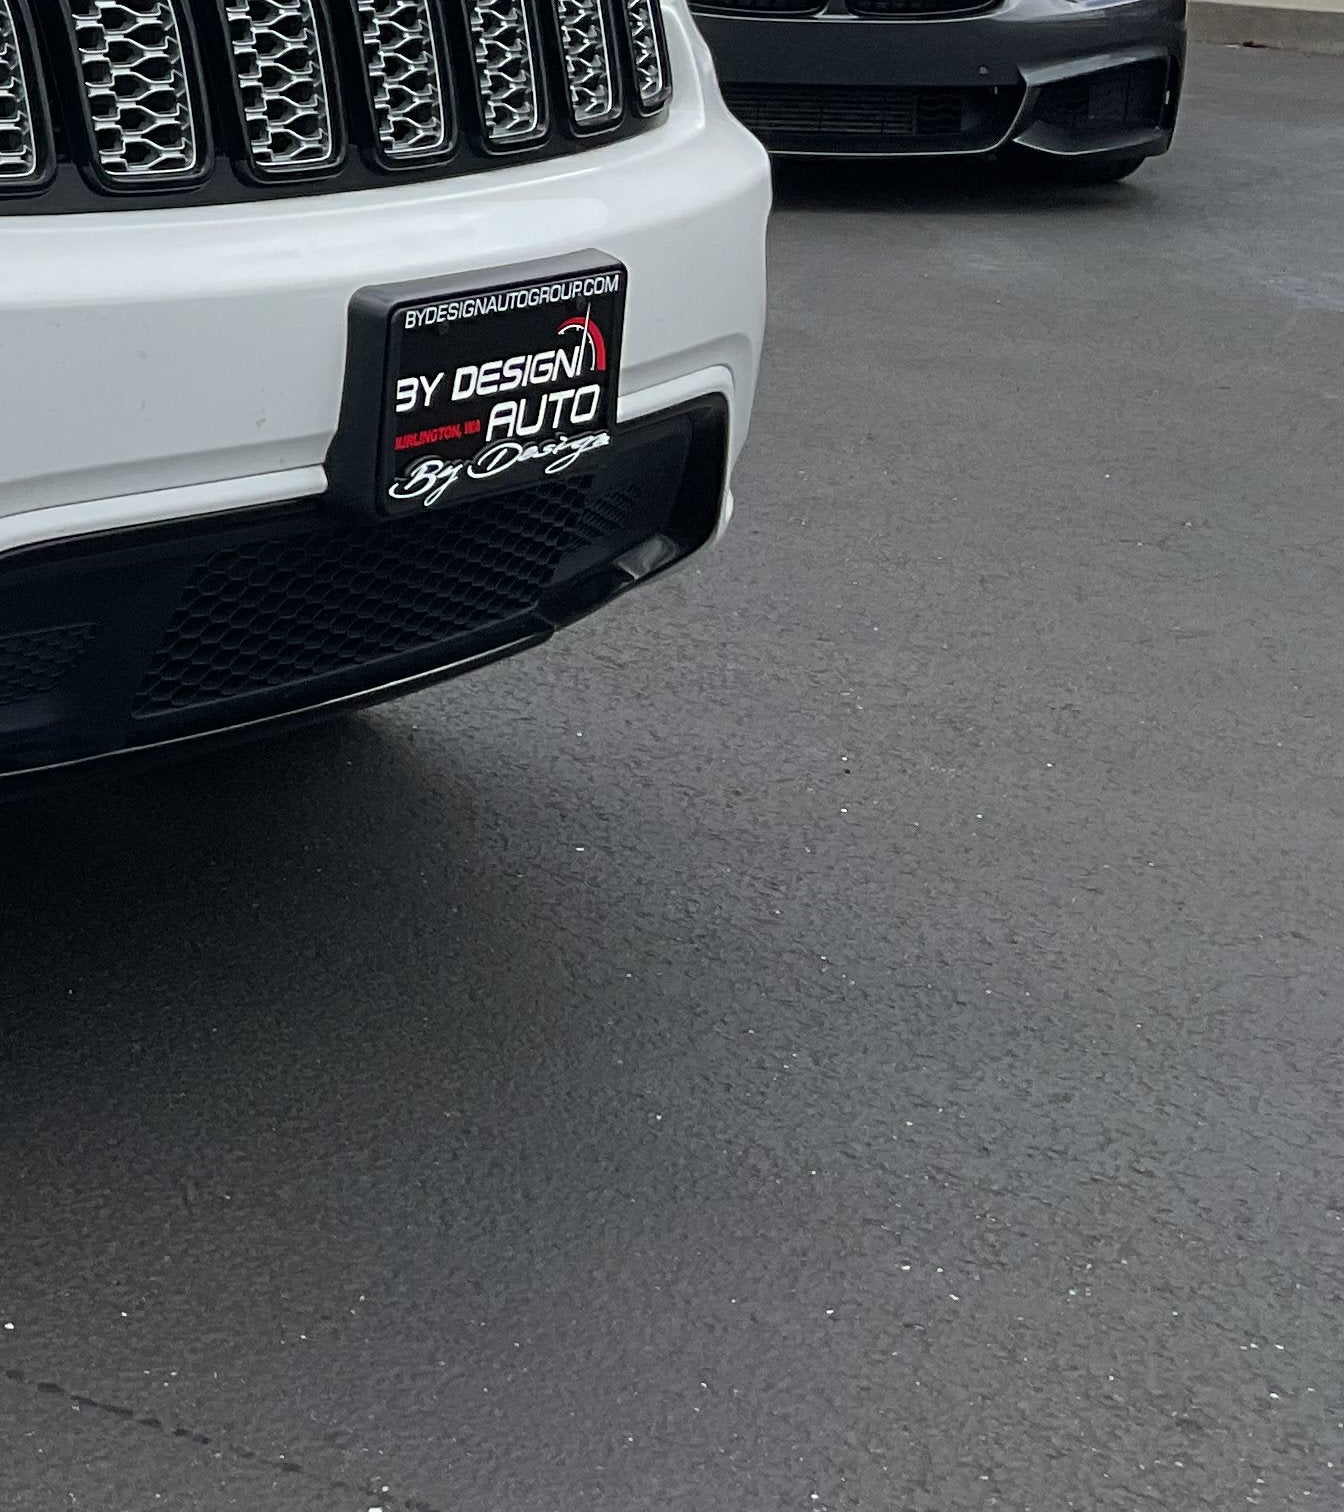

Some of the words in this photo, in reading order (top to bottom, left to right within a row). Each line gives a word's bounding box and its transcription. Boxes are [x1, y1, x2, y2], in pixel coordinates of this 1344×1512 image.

[404, 274, 620, 329] BYDESIGNAUTOGROUP.COM
[395, 372, 444, 413] BY
[451, 345, 583, 401] DESIGN
[485, 384, 600, 442] AUTO
[388, 459, 459, 507] By
[467, 432, 610, 479] Design
